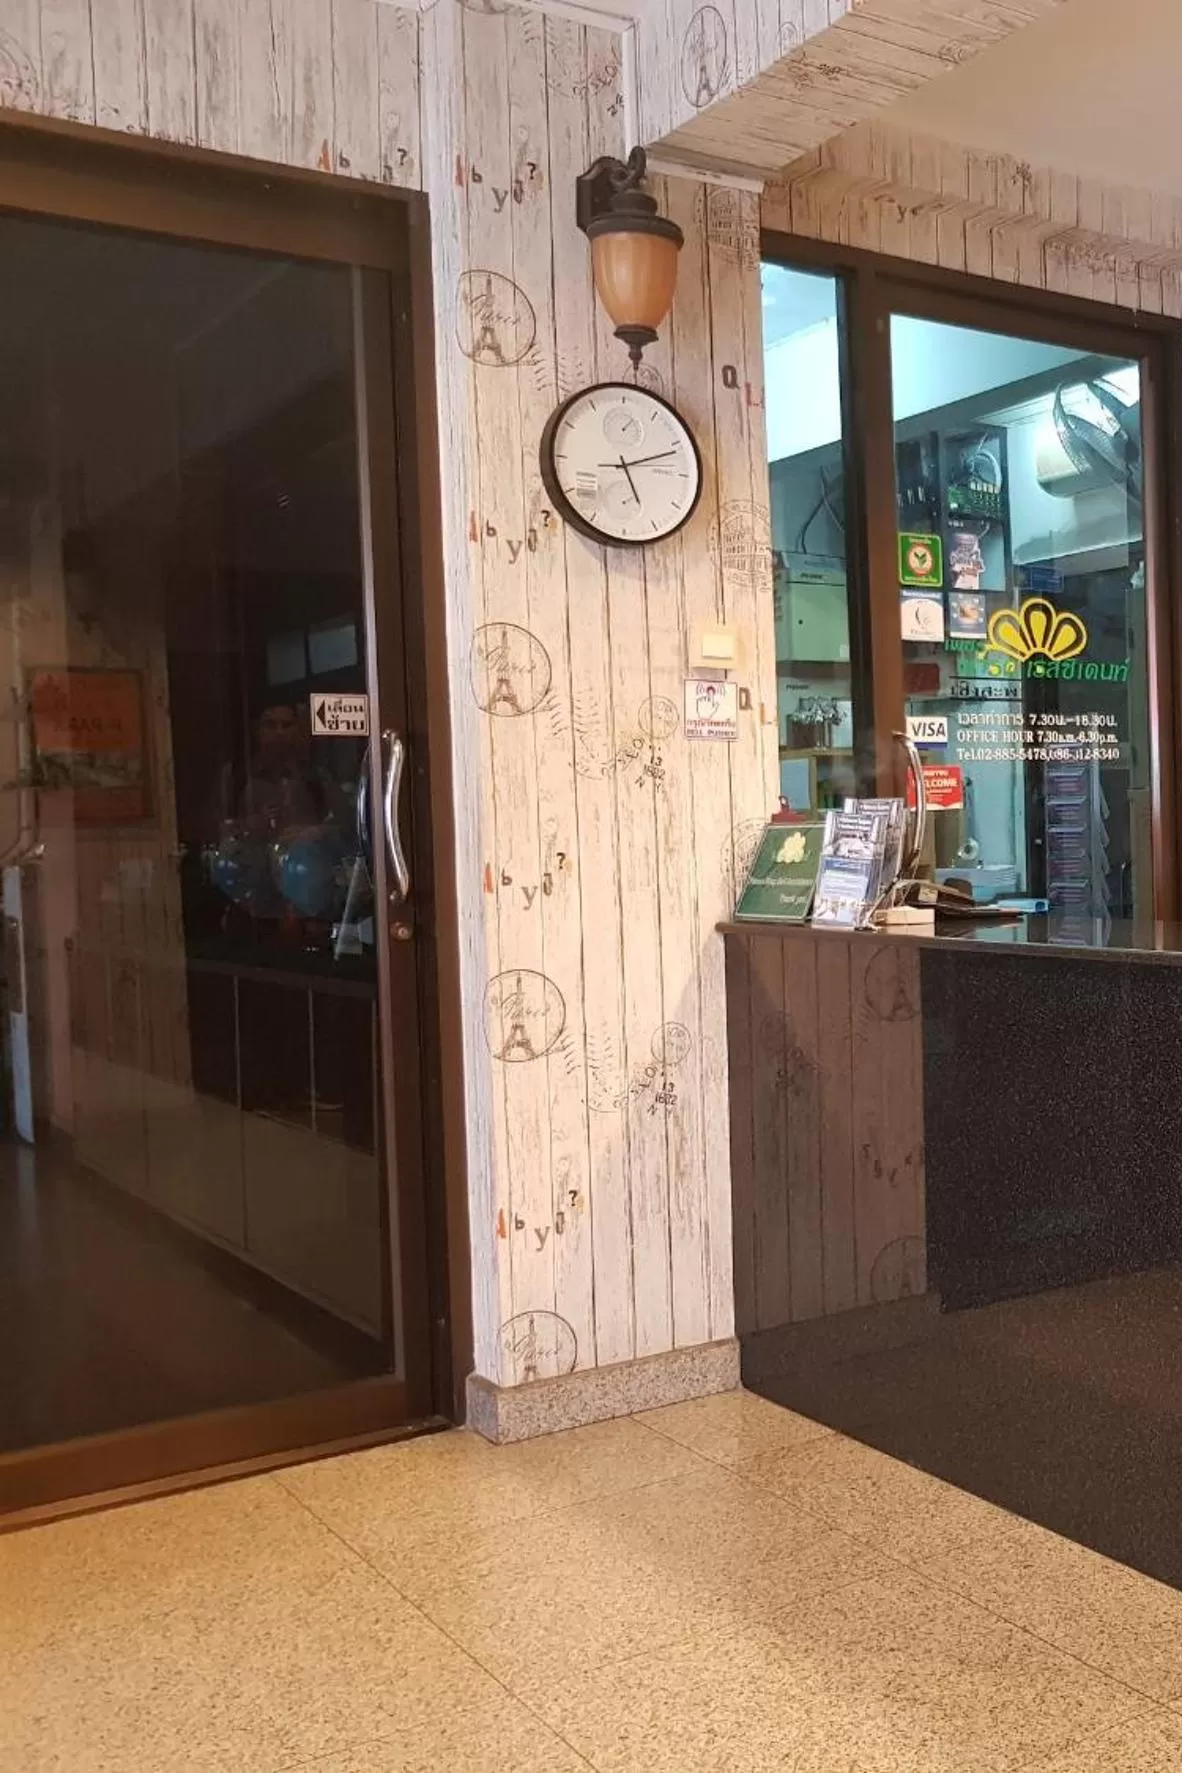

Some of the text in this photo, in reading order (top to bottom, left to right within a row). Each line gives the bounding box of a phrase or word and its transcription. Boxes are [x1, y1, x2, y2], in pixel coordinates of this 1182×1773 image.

[911, 722, 947, 737] VISA
[957, 730, 999, 743] OFFICE
[1003, 730, 1035, 743] HOUR
